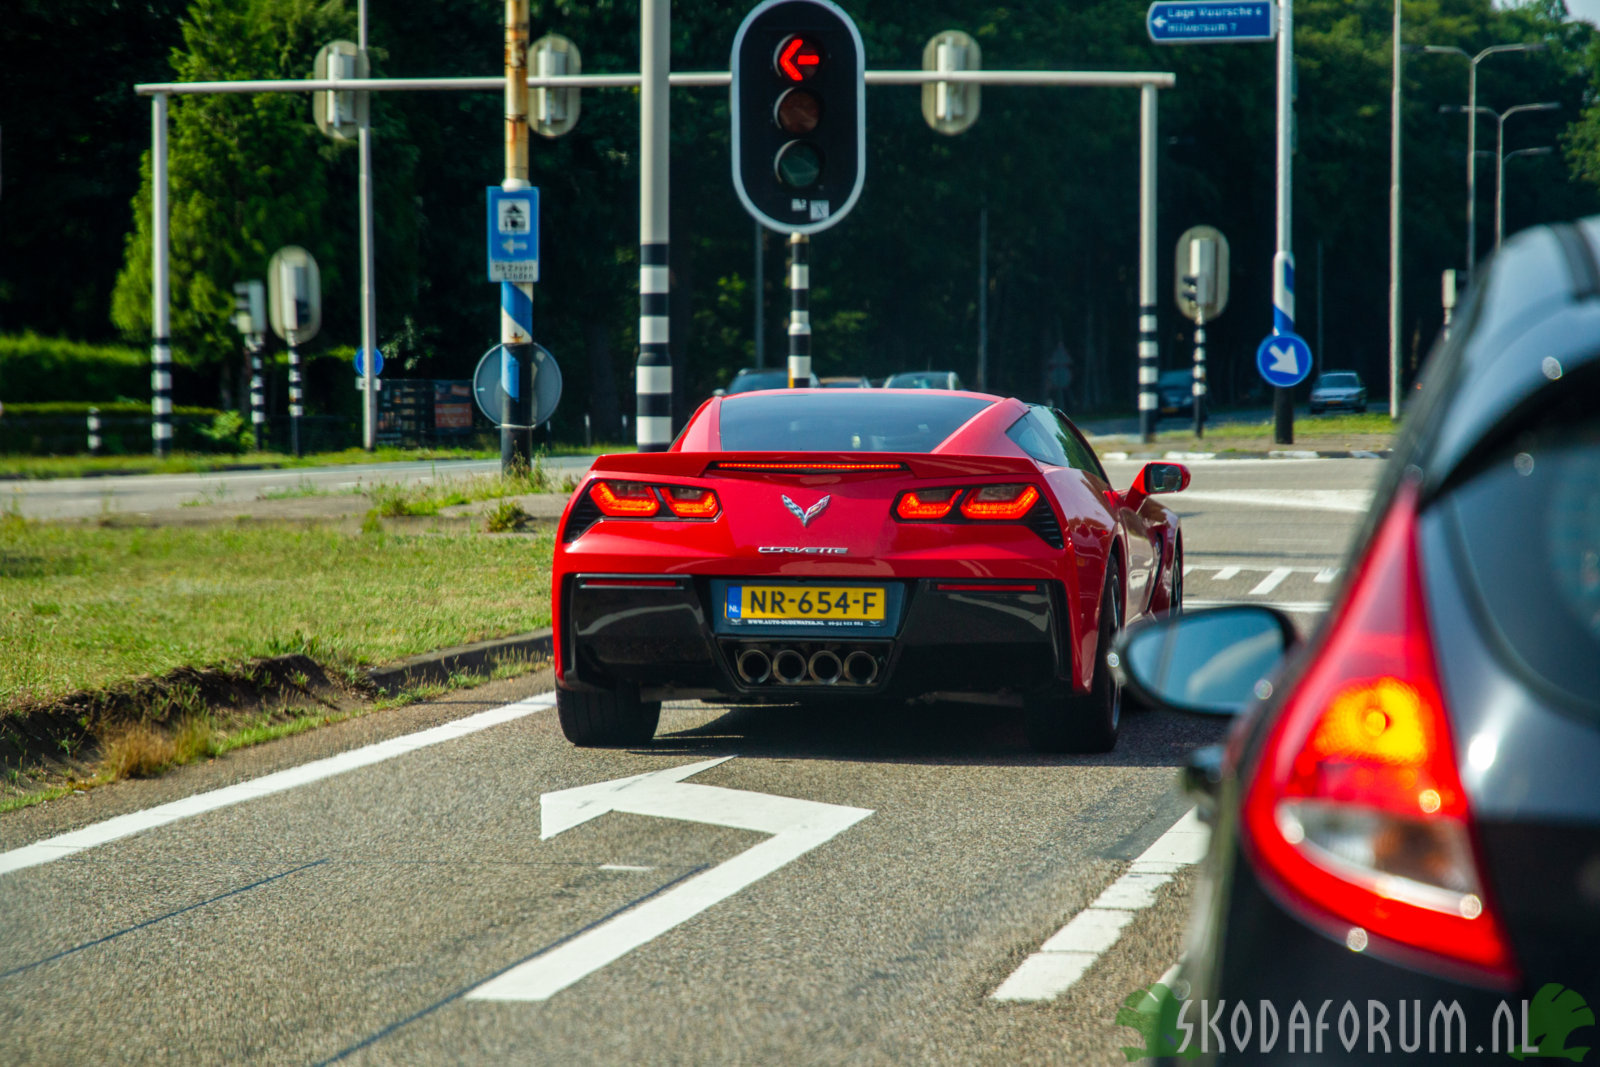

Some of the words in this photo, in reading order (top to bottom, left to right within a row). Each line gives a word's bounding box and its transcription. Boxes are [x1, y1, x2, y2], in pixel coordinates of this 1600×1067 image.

[1167, 7, 1195, 19] Lage
[750, 590, 877, 614] NR-654-F
[728, 605, 739, 613] NL
